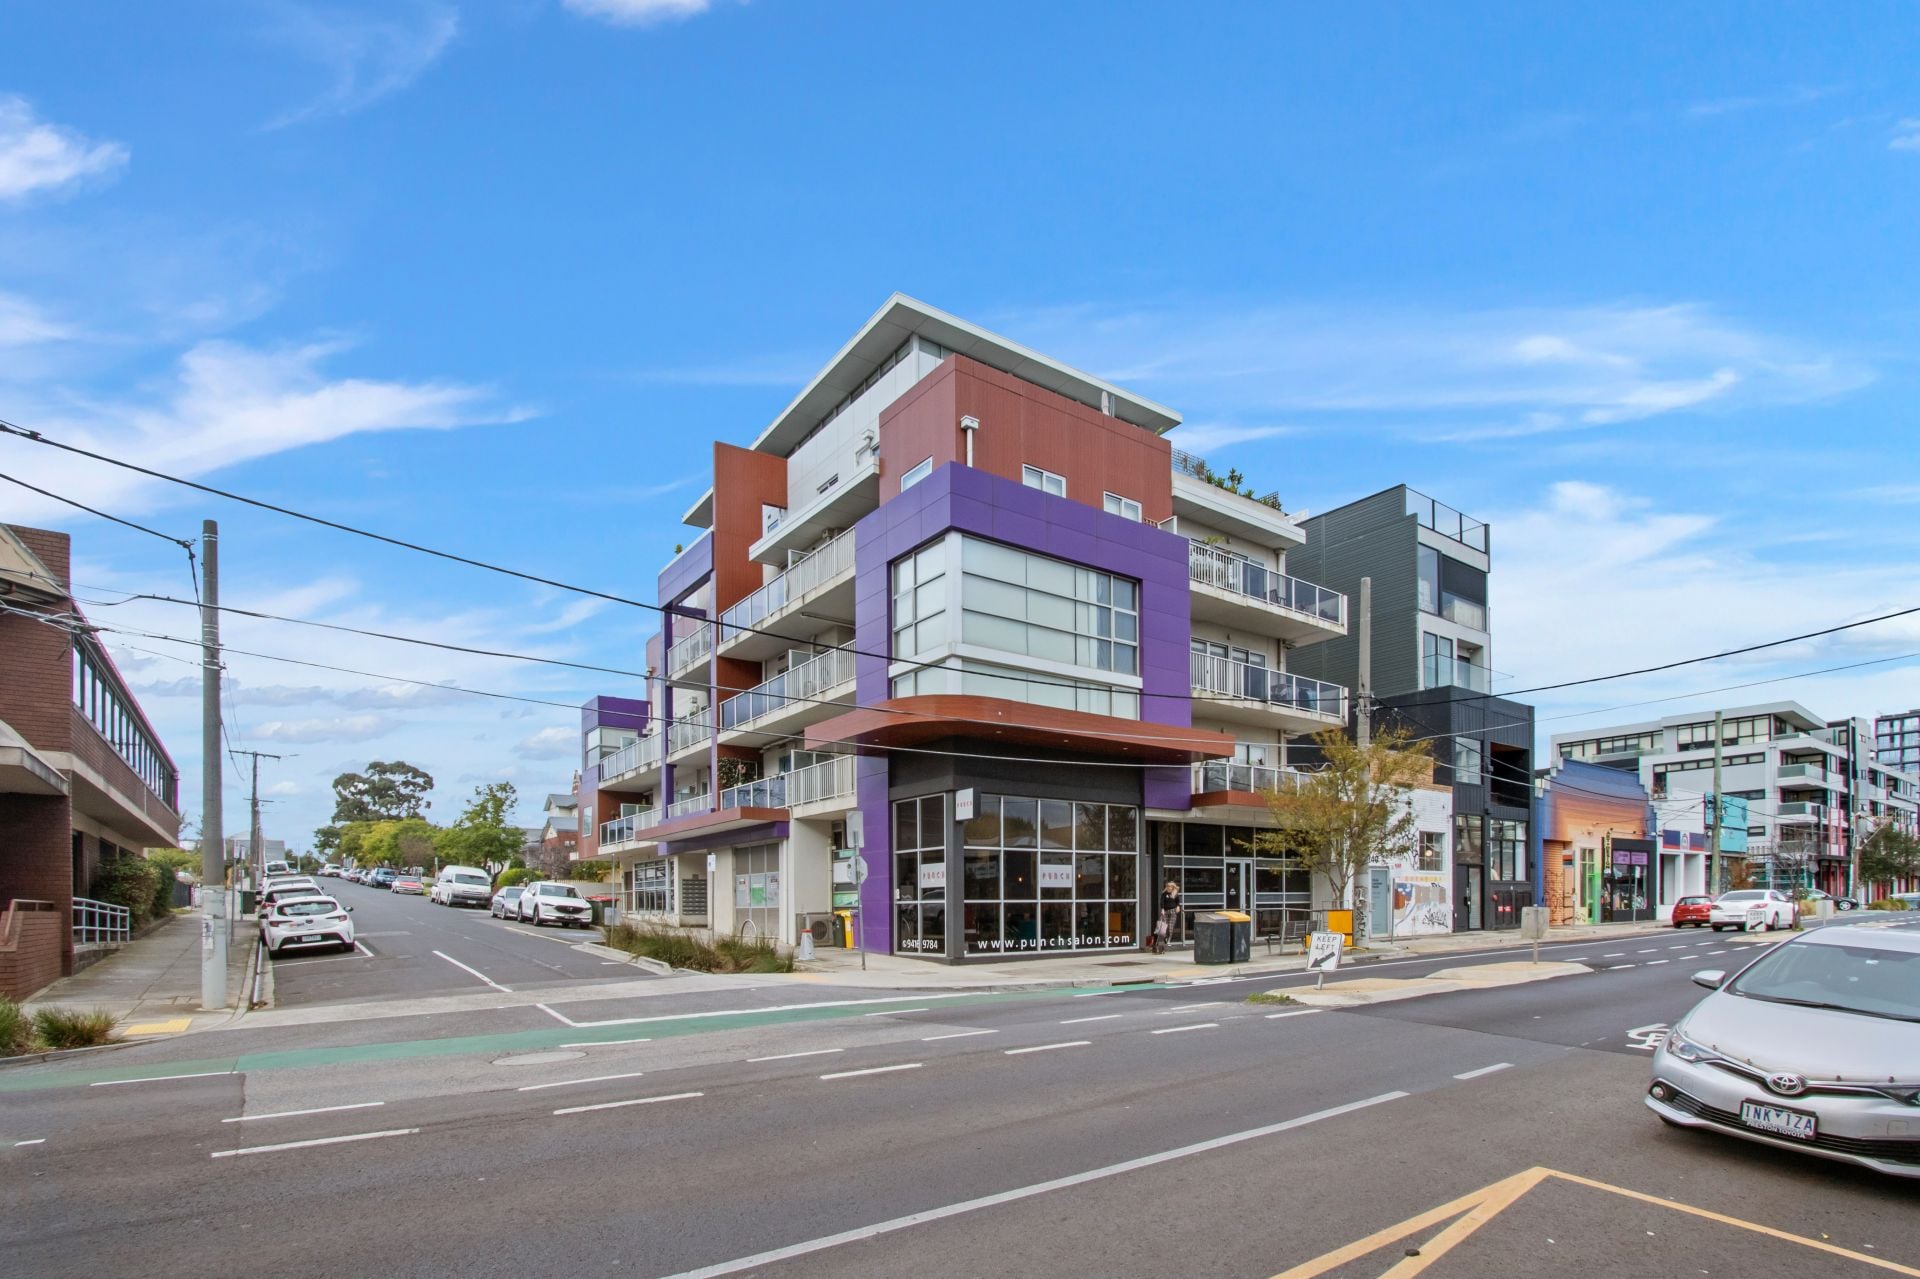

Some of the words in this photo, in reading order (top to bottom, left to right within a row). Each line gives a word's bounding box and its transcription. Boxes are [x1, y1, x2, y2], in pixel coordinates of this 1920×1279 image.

[922, 870, 945, 880] PUNCH
[1042, 872, 1070, 881] PUNCH
[922, 939, 938, 950] 9784
[977, 934, 1130, 950] www.punchsalon.com
